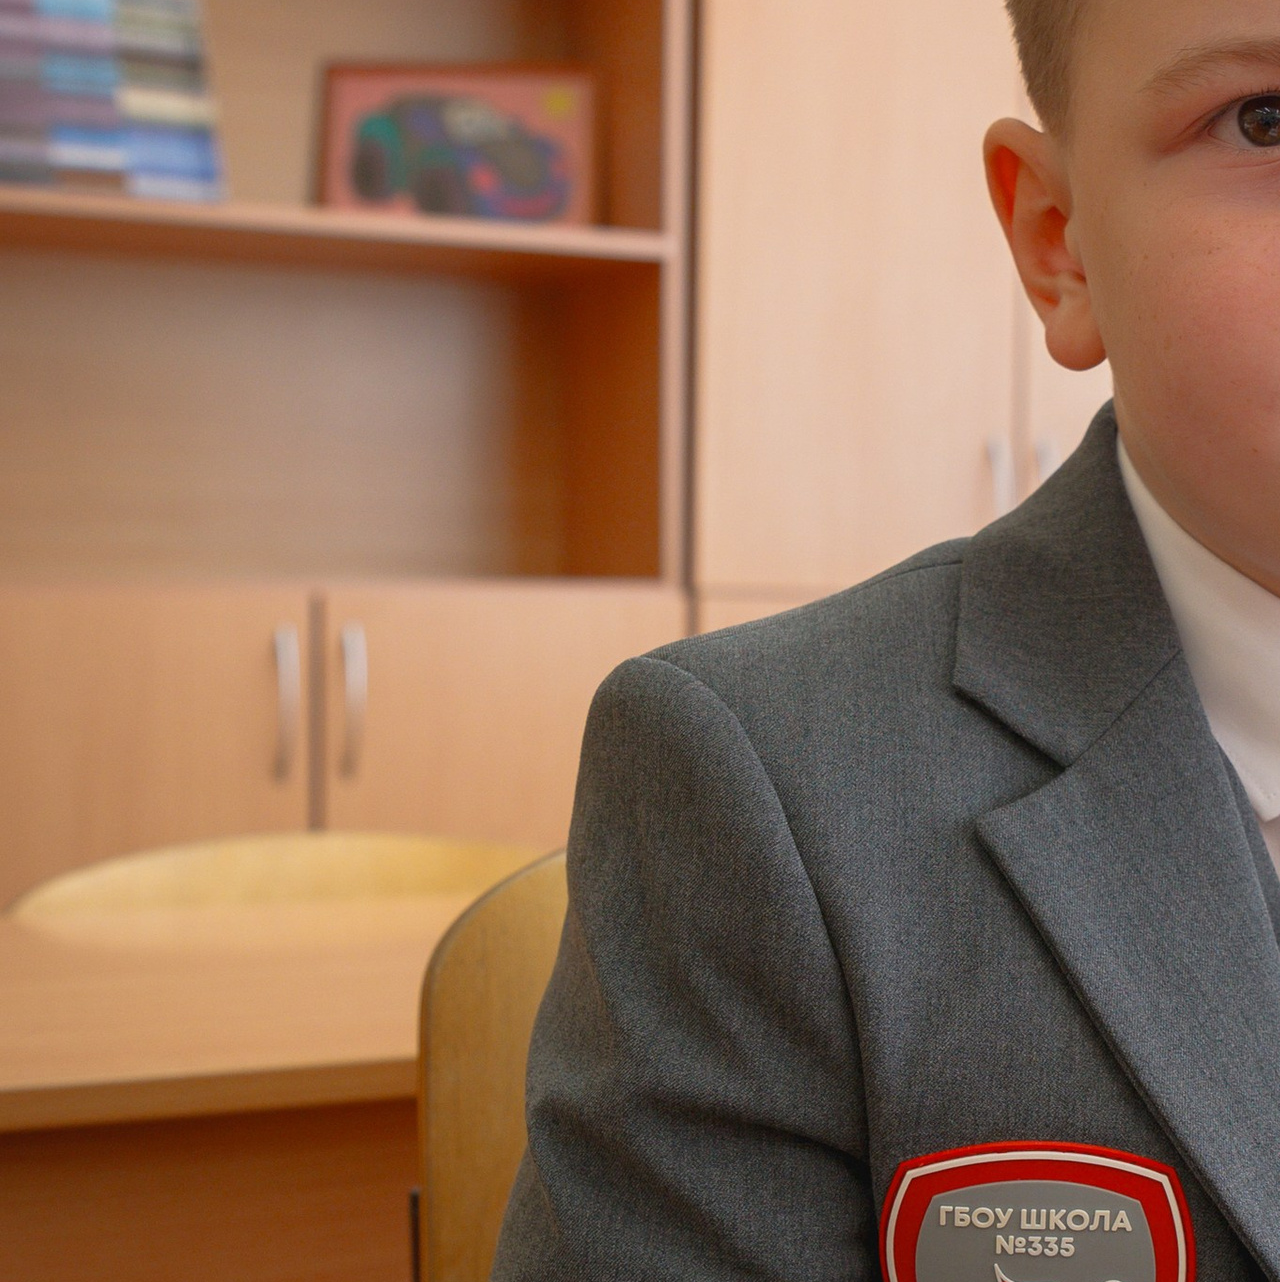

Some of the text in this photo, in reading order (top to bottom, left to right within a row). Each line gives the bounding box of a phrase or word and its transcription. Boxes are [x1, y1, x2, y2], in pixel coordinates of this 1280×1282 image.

[939, 1205, 1132, 1231] ГБОУ ШКОЛА
[995, 1235, 1075, 1257] №335
